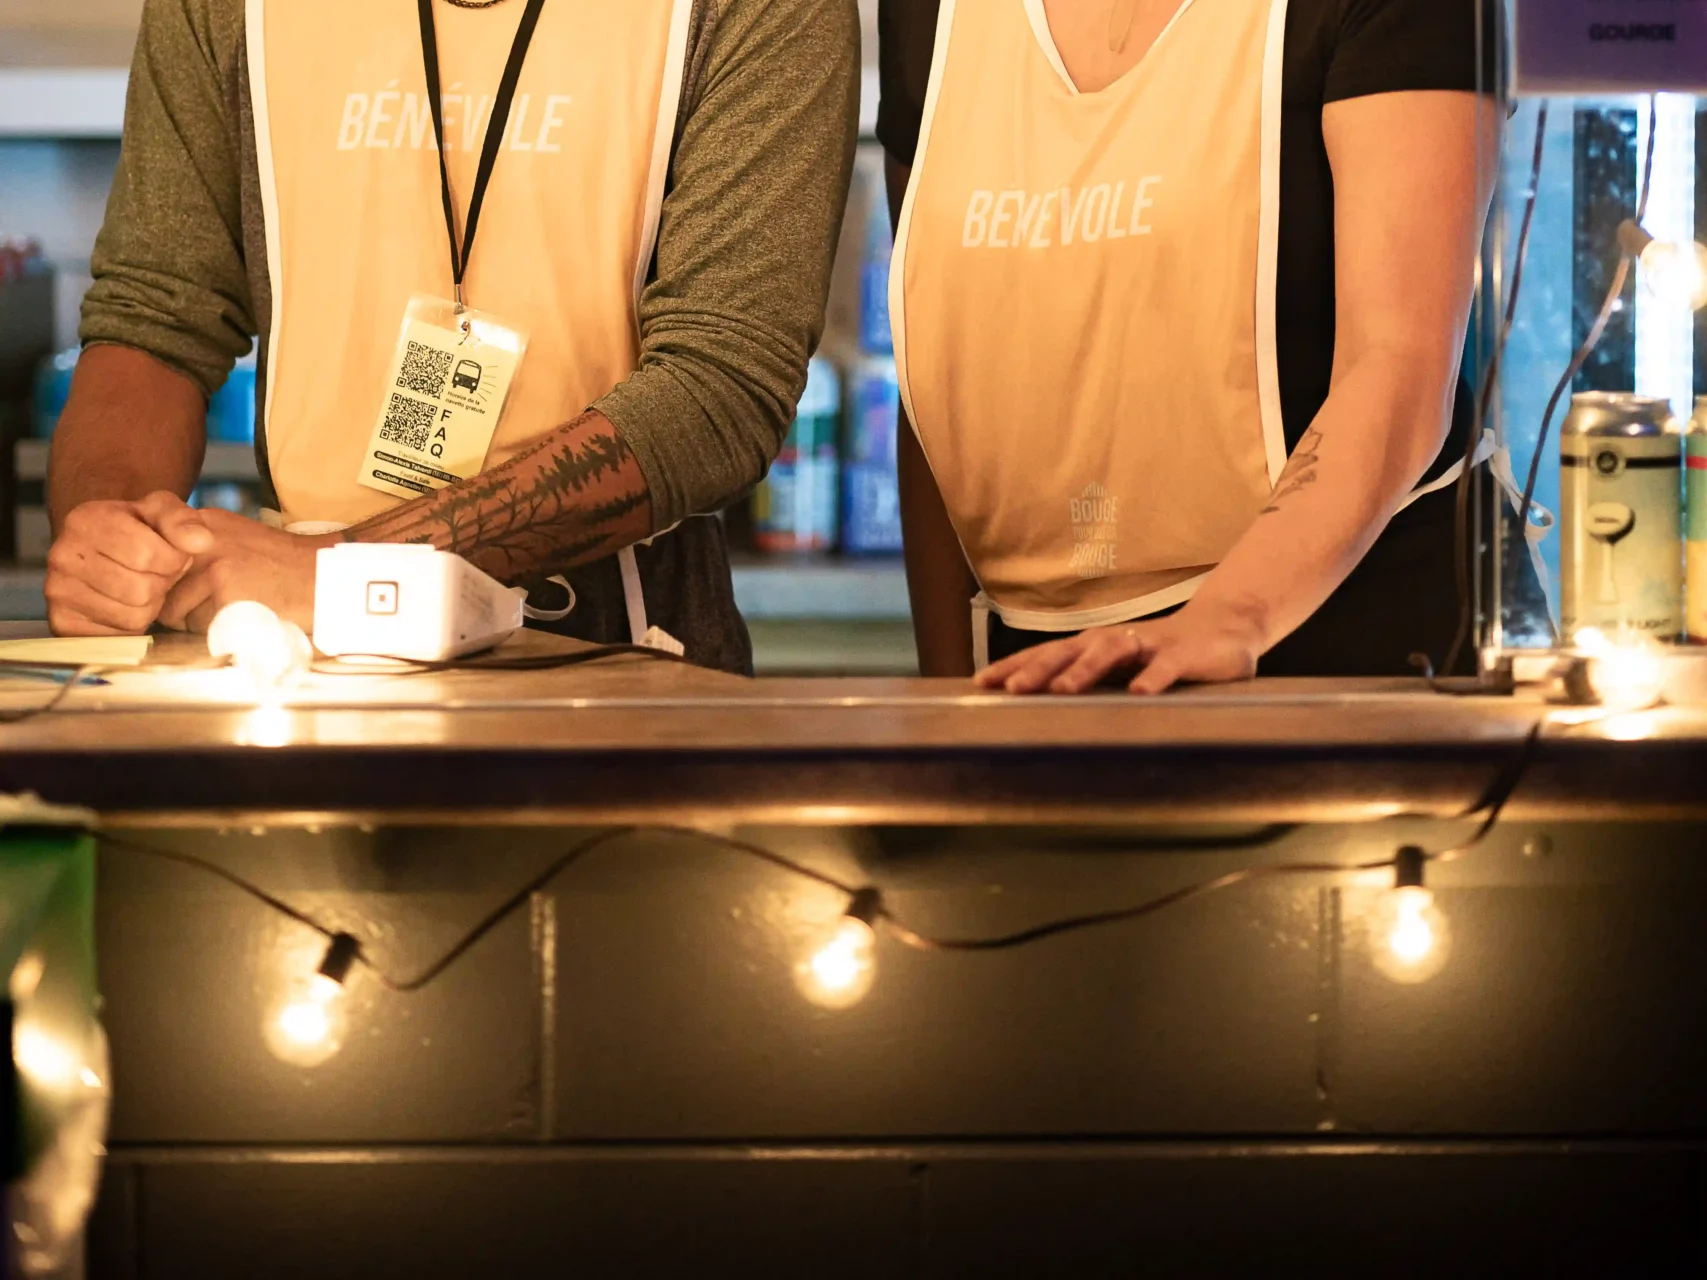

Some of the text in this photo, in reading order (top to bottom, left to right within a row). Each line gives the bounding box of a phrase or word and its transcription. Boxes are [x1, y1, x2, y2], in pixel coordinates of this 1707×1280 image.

[1587, 22, 1675, 41] GOURDE
[337, 79, 572, 153] BÉNÉVLE
[445, 397, 485, 414] navette gratuite
[1070, 496, 1118, 523] BOUGE
